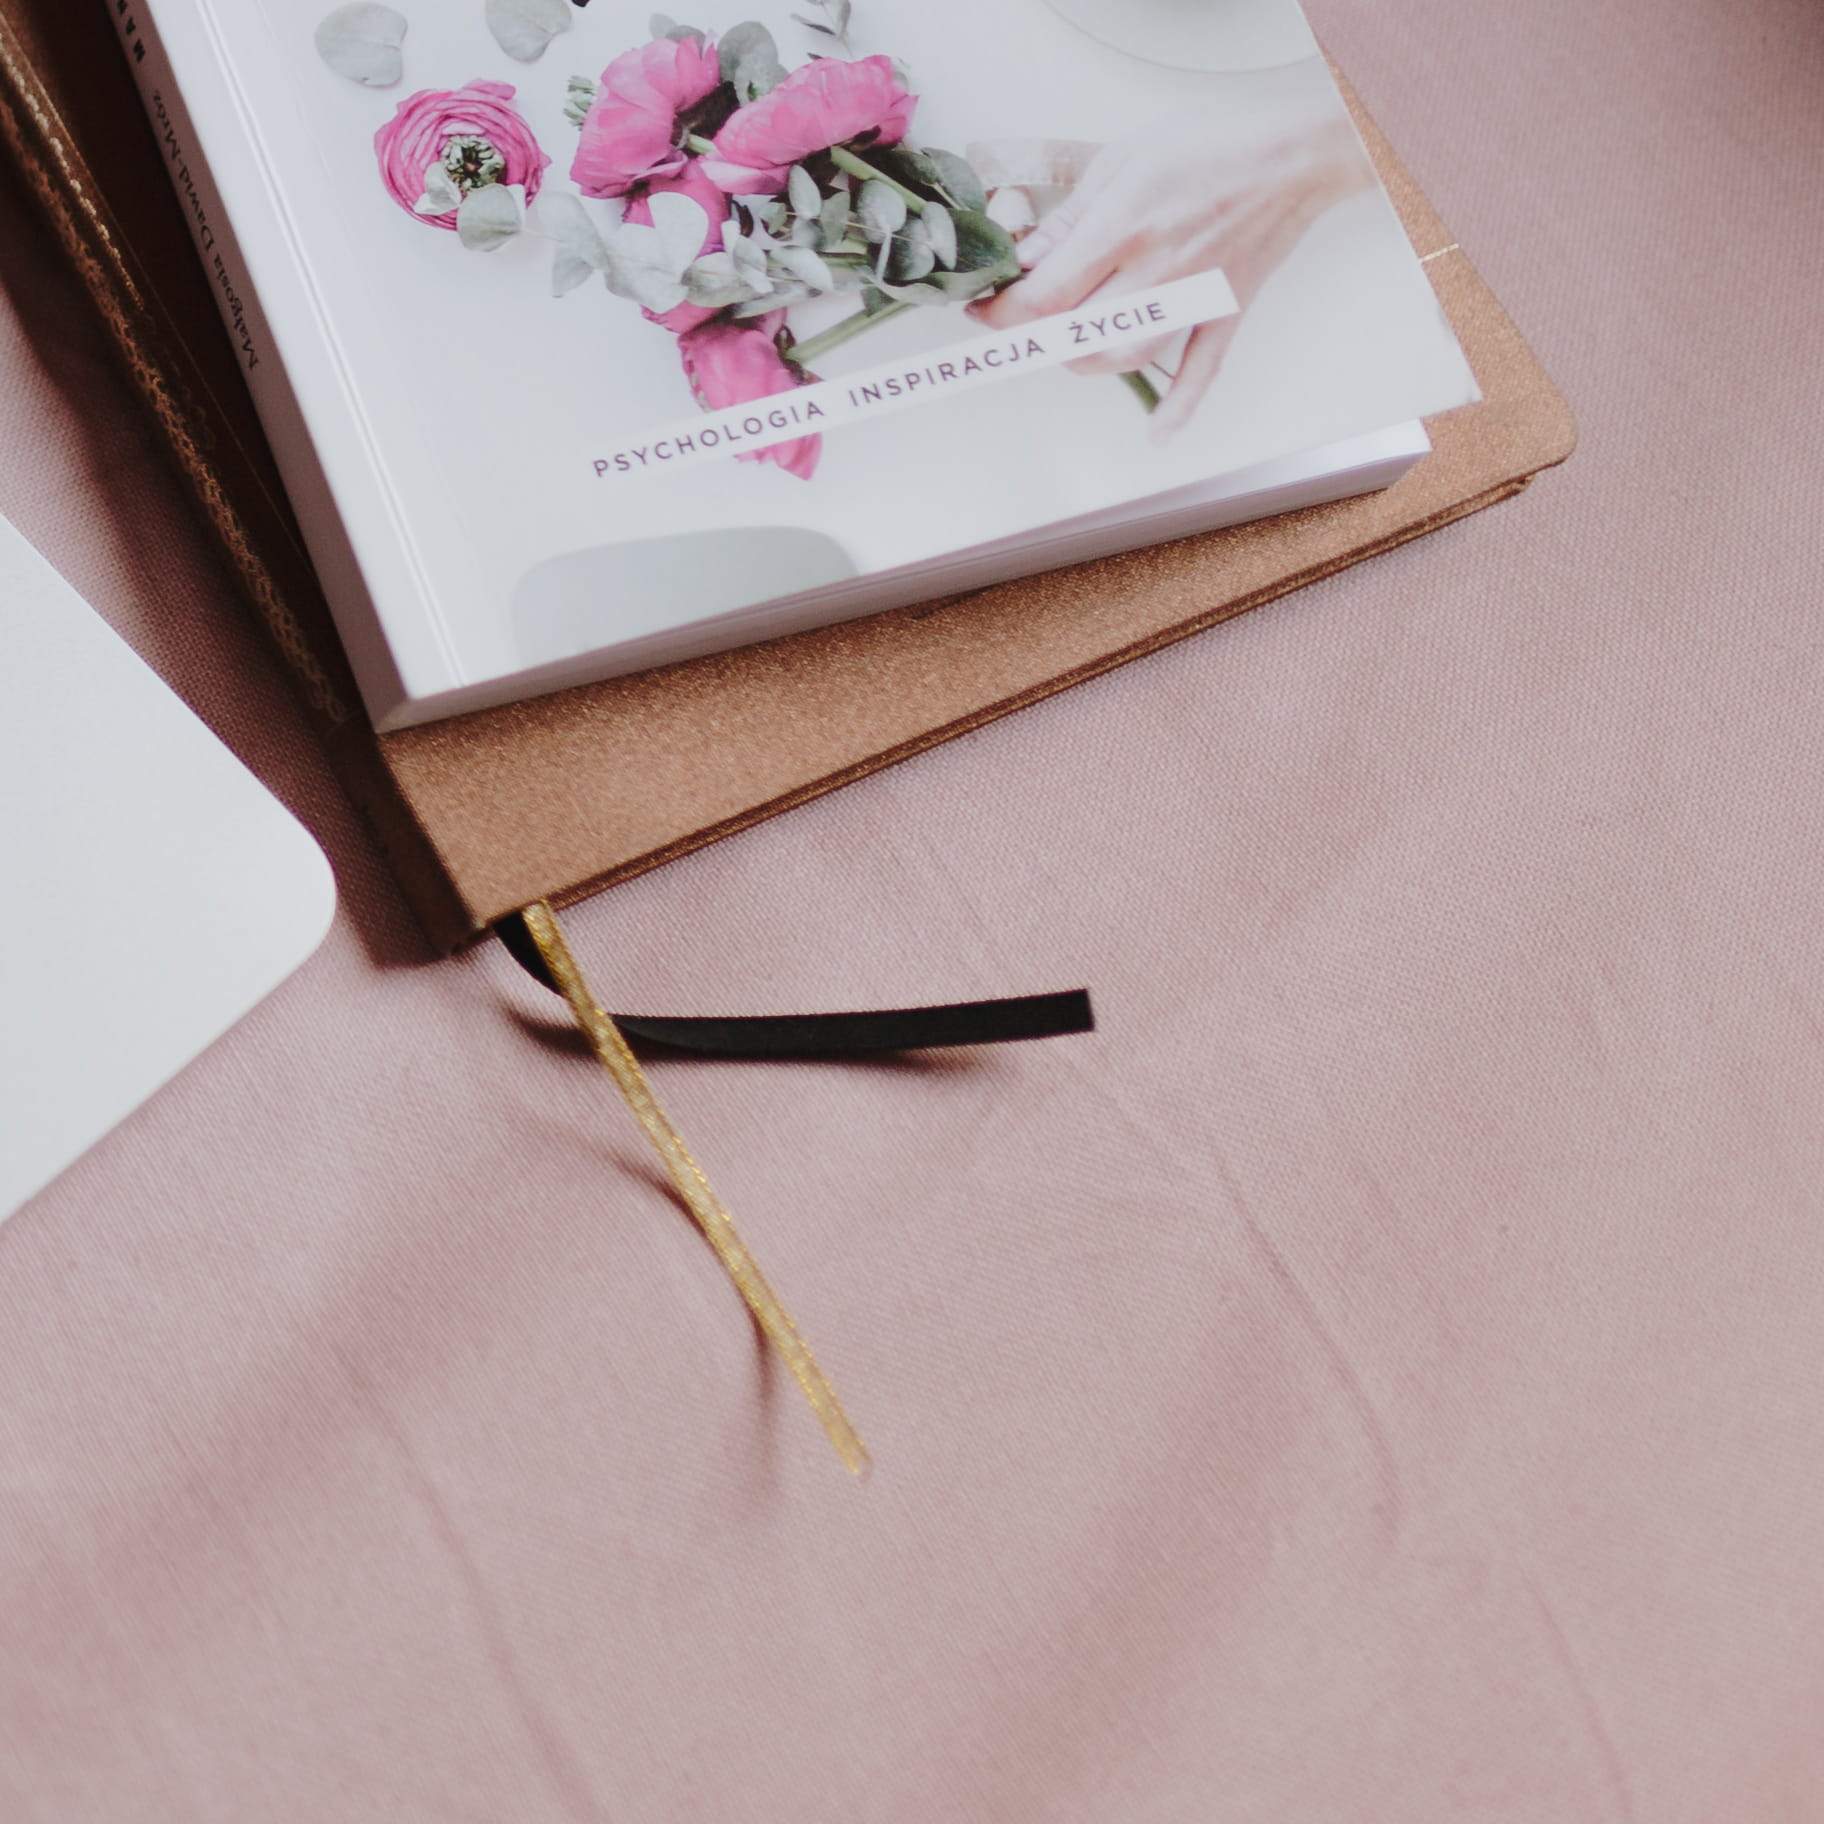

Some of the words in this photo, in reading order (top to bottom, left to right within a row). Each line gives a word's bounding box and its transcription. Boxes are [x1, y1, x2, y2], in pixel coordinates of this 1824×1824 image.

[211, 254, 260, 369] Małgosia
[592, 399, 826, 479] PSYCHOLOGIA
[849, 337, 1046, 408] INSPIRACJA
[1069, 300, 1169, 344] ŻYCIE
